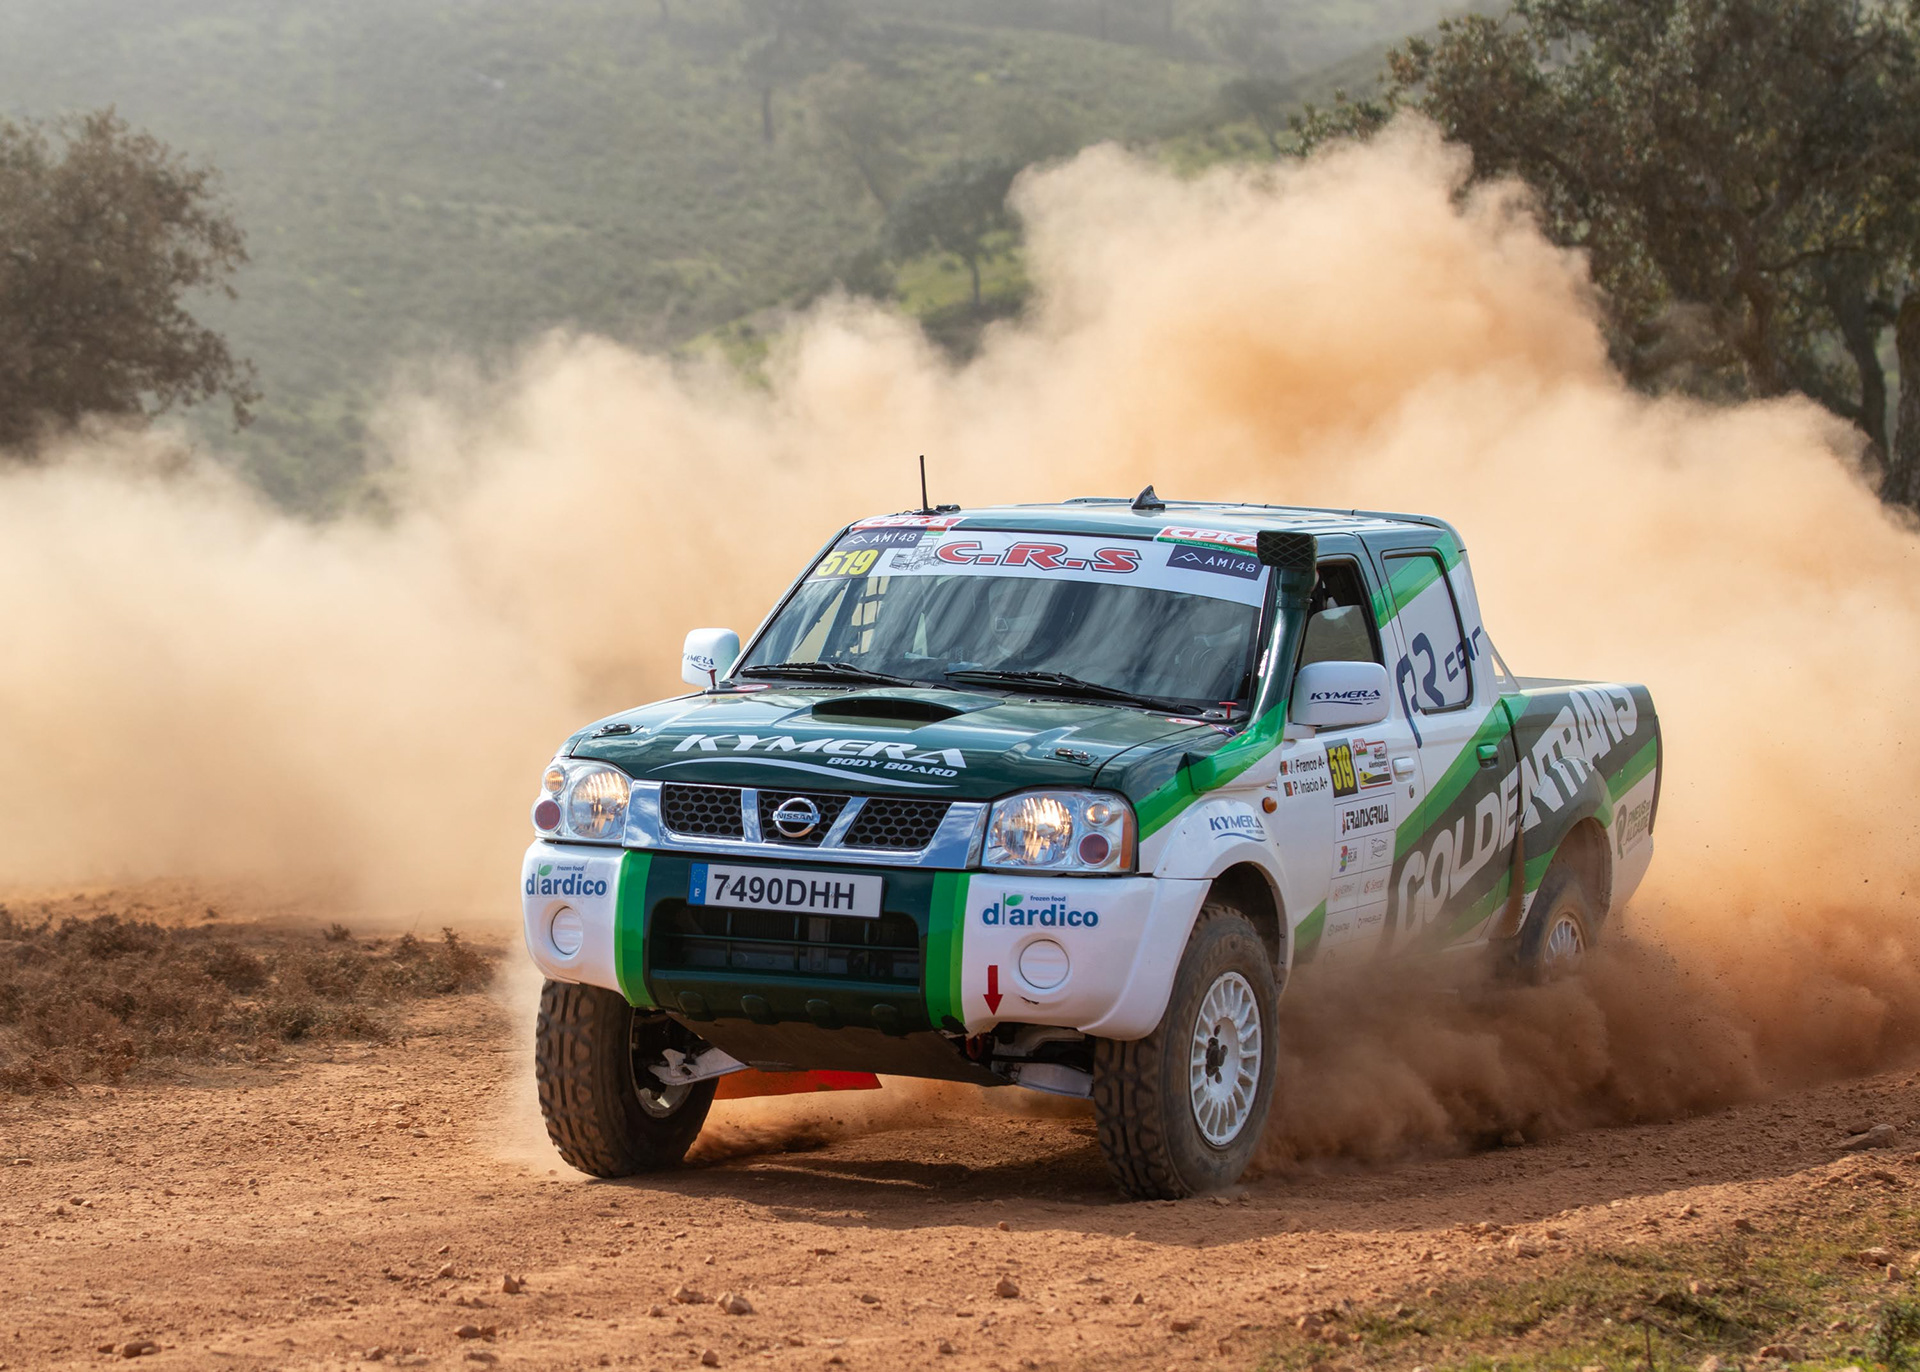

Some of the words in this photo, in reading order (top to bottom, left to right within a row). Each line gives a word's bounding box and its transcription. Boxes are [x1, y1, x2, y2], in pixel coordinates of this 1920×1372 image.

[816, 549, 879, 576] 519
[682, 653, 714, 665] YMERA
[1310, 689, 1381, 700] KYMERA
[672, 734, 967, 769] KYMERA
[826, 757, 883, 769] BODY
[883, 761, 958, 777] BOARD
[1289, 761, 1296, 775] J.
[1296, 759, 1317, 773] Franco
[1327, 745, 1355, 790] 519
[1293, 781, 1300, 795] P.
[1301, 778, 1320, 793] Inácio
[1320, 776, 1328, 790] A+
[776, 812, 815, 821] NISSAN
[1398, 684, 1638, 936] GOLDENTRANS
[1209, 815, 1263, 831] KYMERA
[713, 874, 855, 910] 7490DHH
